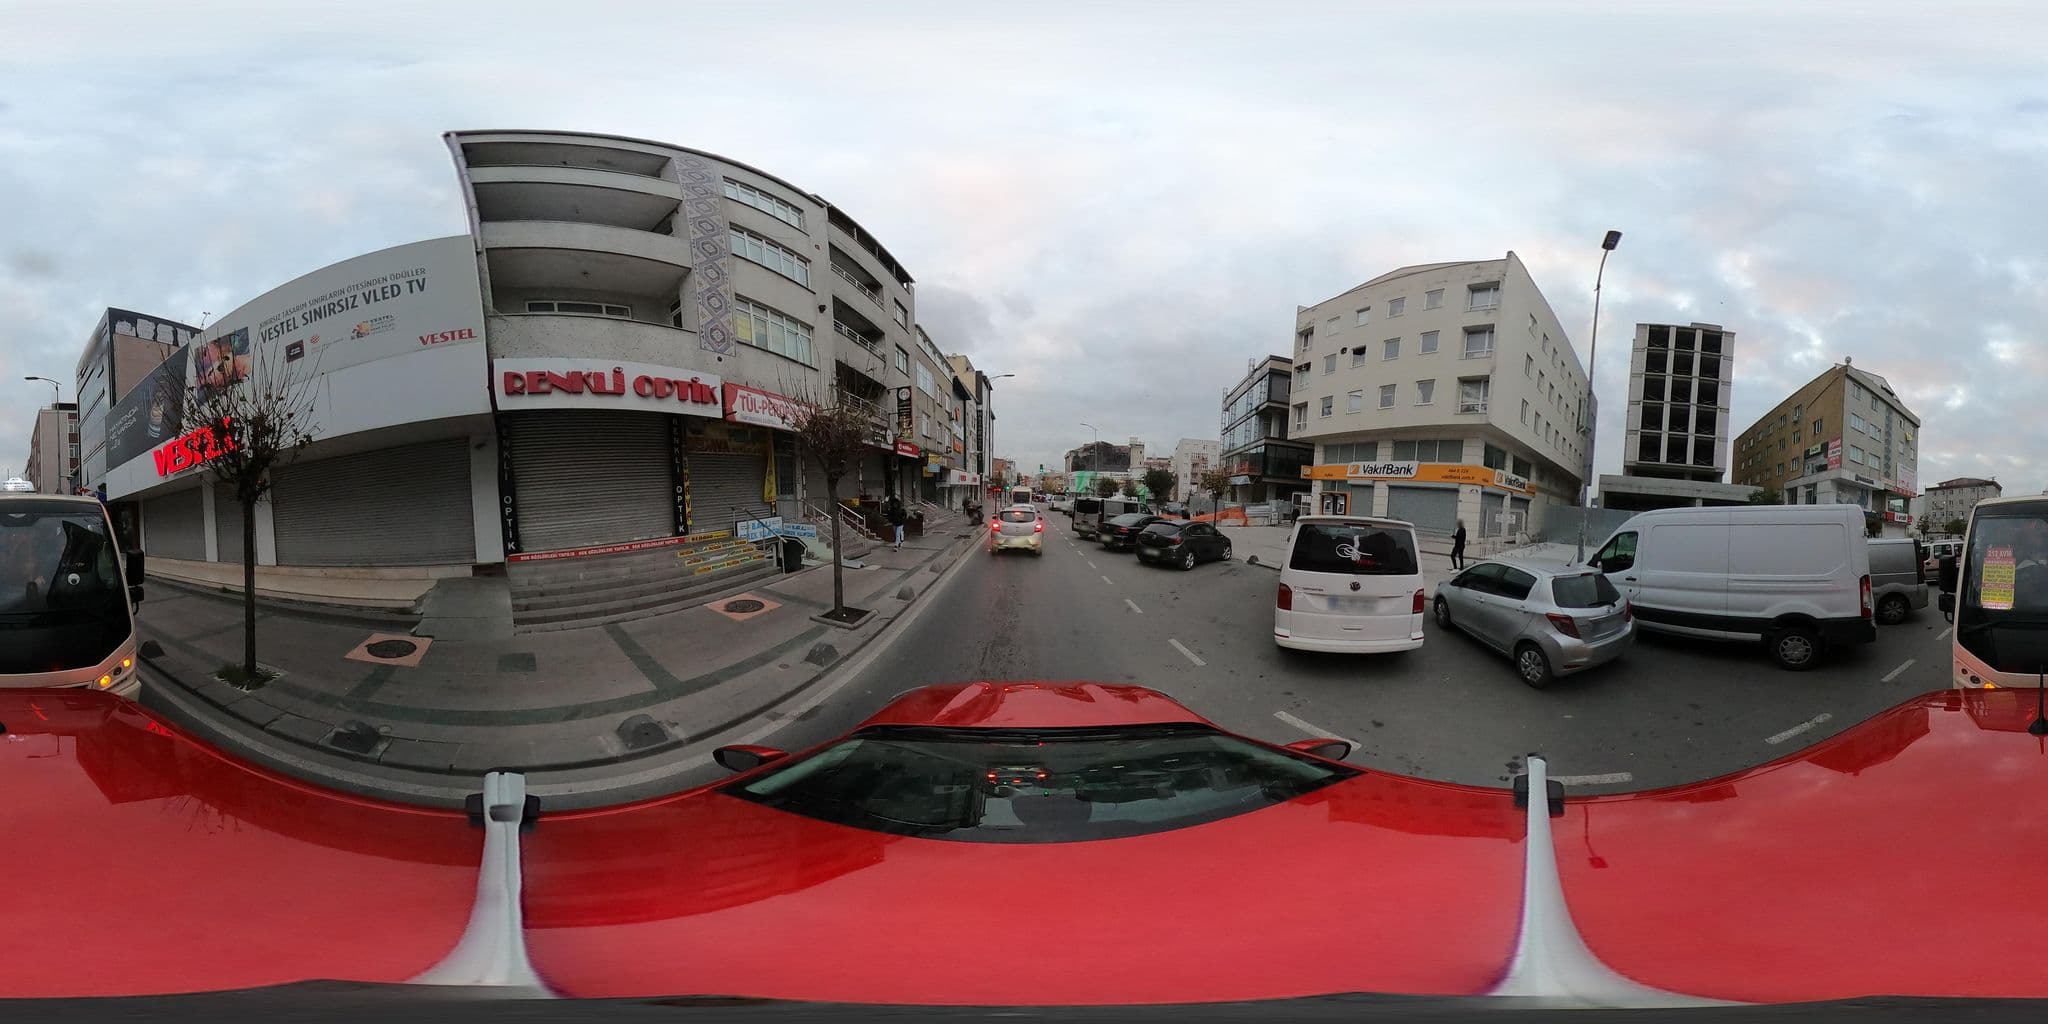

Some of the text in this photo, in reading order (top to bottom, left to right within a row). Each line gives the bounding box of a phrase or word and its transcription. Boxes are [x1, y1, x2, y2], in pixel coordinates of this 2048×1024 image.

[260, 278, 427, 344] VESTEL SINIRSIZ VLED TV
[418, 328, 477, 346] VESTEL
[503, 366, 719, 405] RENKLİ OPTİK
[1362, 463, 1414, 476] VakıfBank
